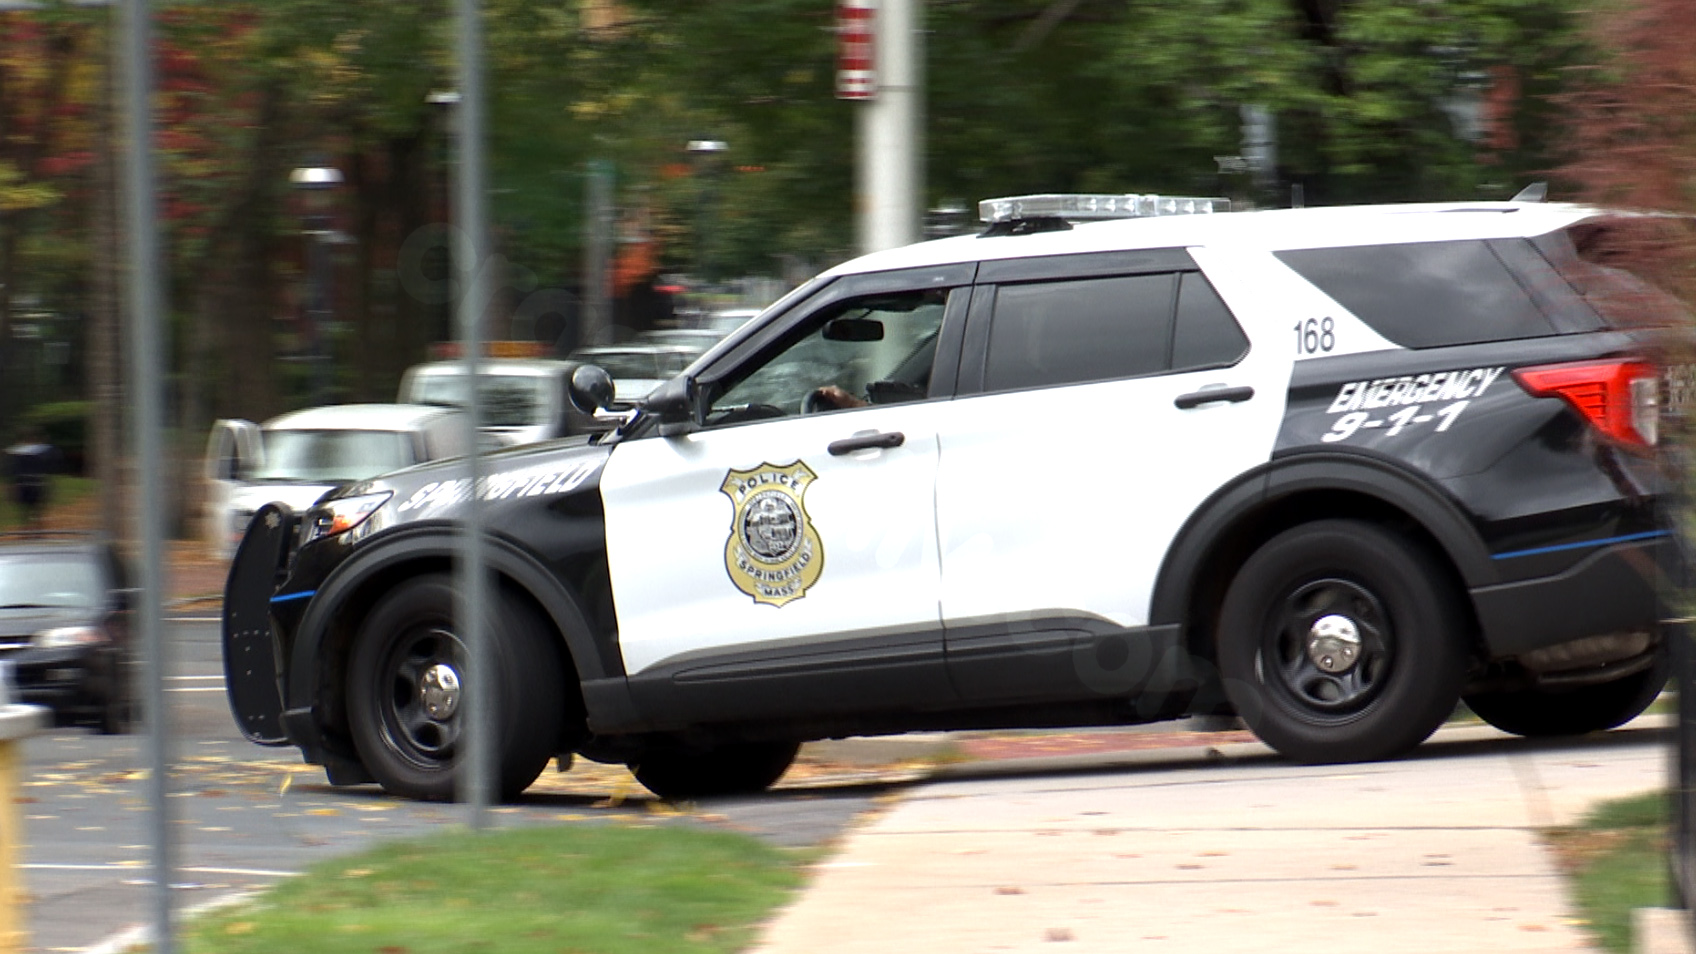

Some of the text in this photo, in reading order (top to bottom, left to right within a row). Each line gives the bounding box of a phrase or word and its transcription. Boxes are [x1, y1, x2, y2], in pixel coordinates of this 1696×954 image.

[1293, 316, 1335, 354] 168
[1326, 367, 1506, 413] EMERGENCY
[1321, 401, 1471, 442] 9-1-1
[397, 460, 602, 512] SPRGFIELD
[739, 473, 800, 495] POLICE
[738, 553, 811, 581] SPRINGFIELD
[764, 586, 795, 597] MASS
